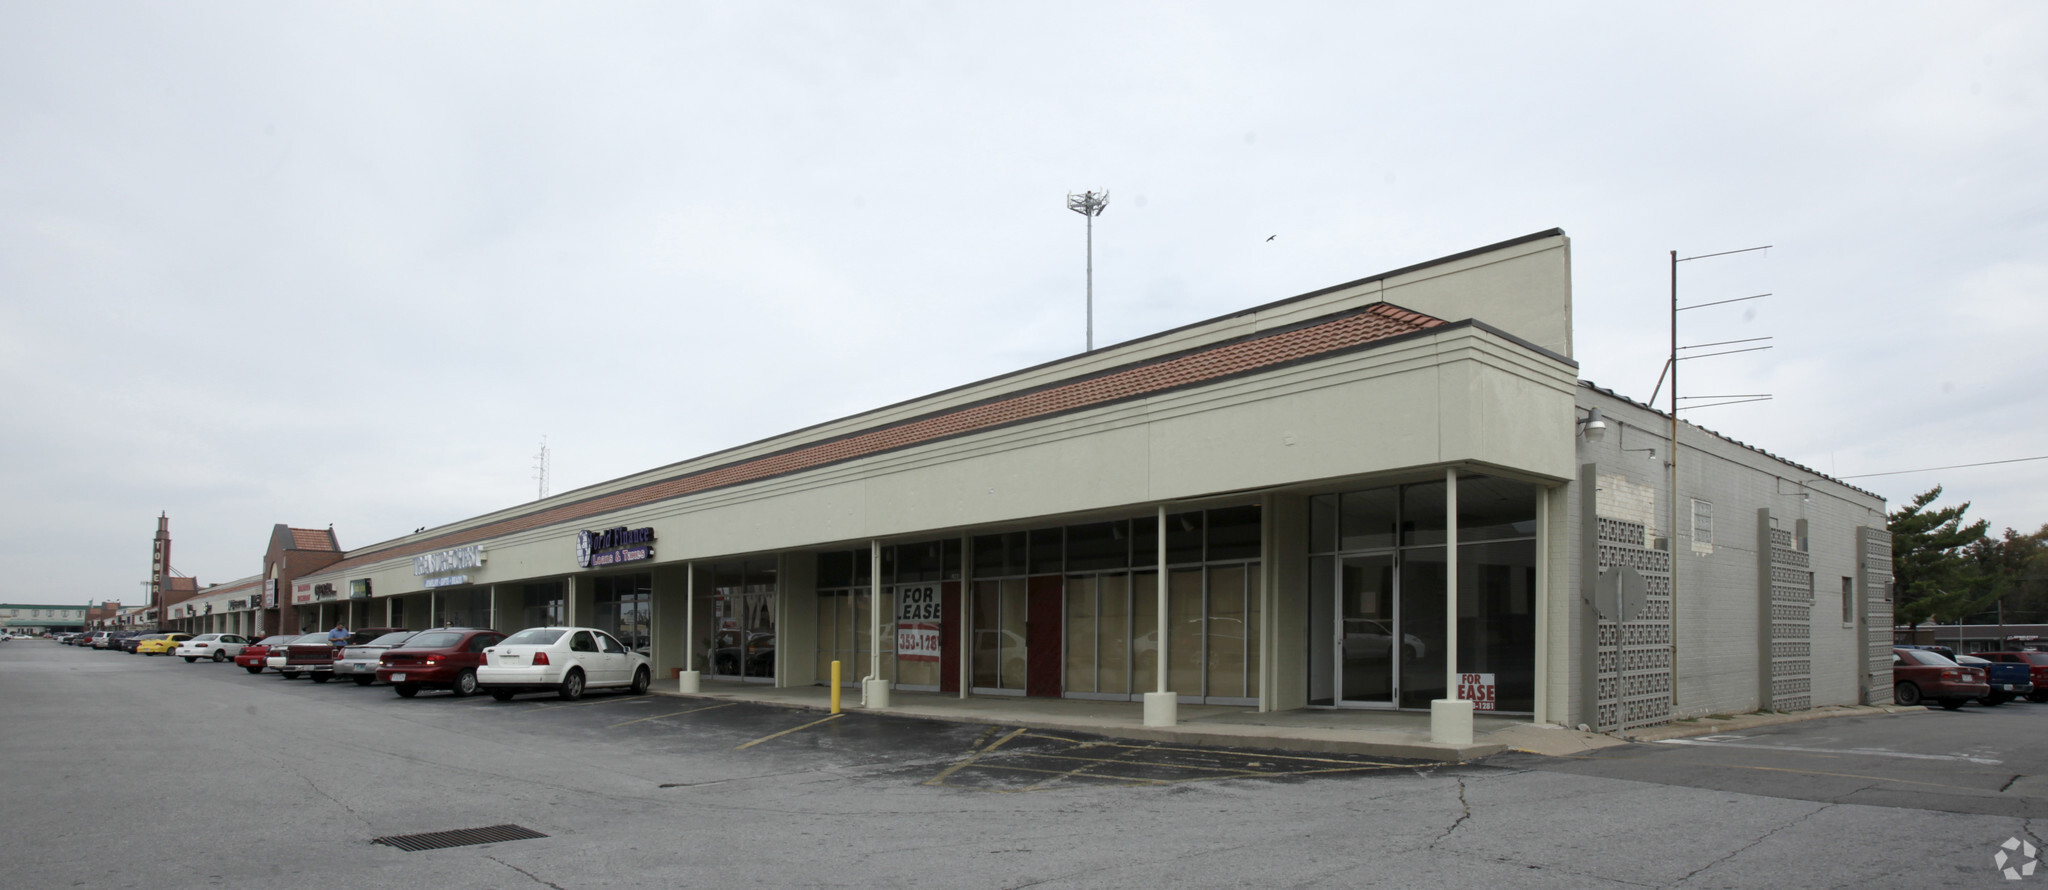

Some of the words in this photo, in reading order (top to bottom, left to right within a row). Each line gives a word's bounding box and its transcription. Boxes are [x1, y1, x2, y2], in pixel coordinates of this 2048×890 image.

[614, 527, 650, 547] Finance
[614, 550, 622, 563] &
[902, 587, 933, 604] FOR
[1462, 673, 1481, 685] FOR
[1458, 685, 1494, 700] EASE
